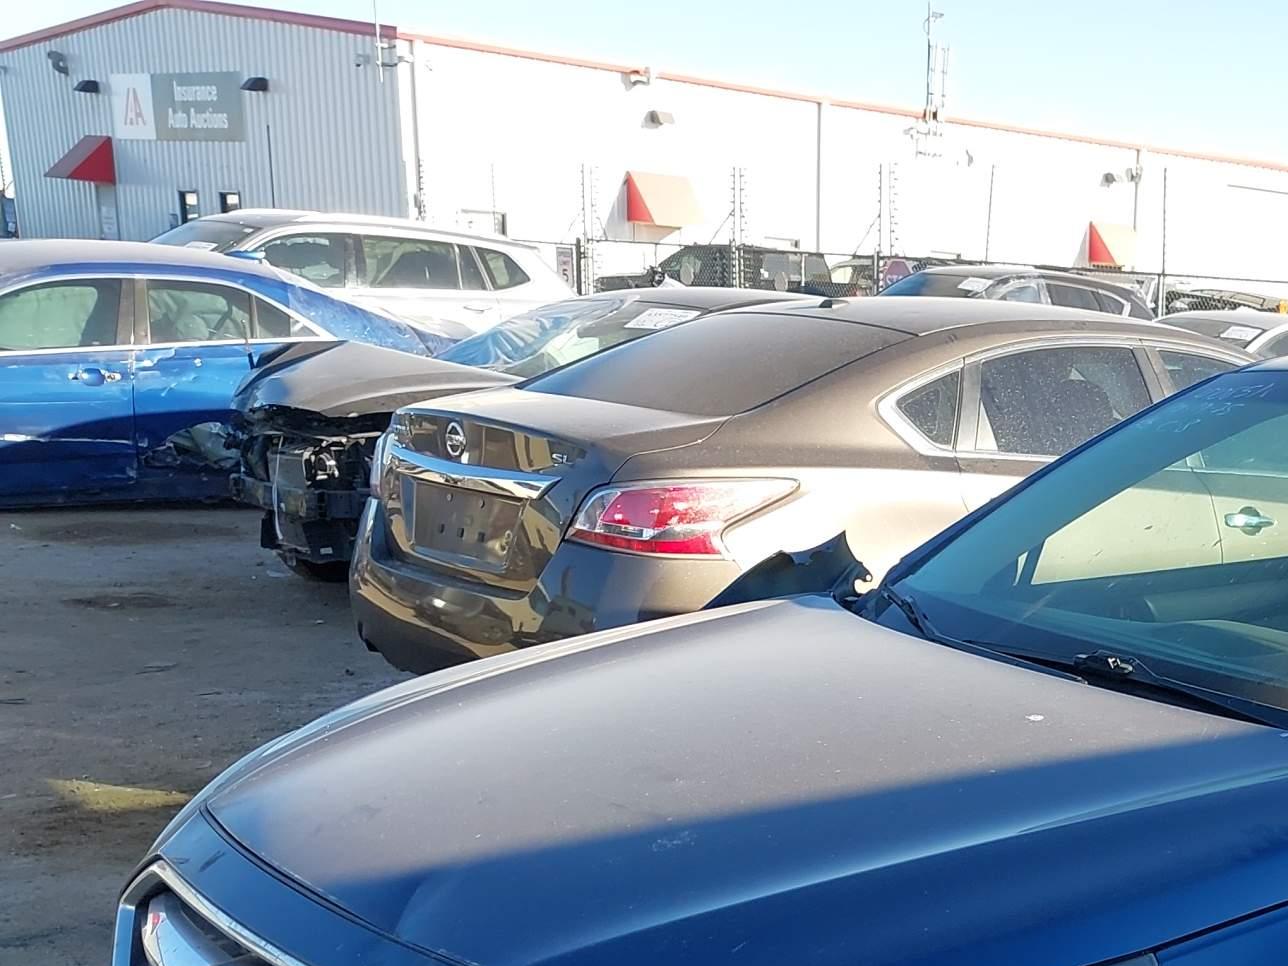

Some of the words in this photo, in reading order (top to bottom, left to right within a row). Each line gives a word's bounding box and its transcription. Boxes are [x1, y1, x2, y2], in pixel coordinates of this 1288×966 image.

[173, 80, 218, 101] Insurance
[168, 107, 188, 128] Auto
[190, 107, 229, 129] Auctions
[551, 453, 573, 465] SL
